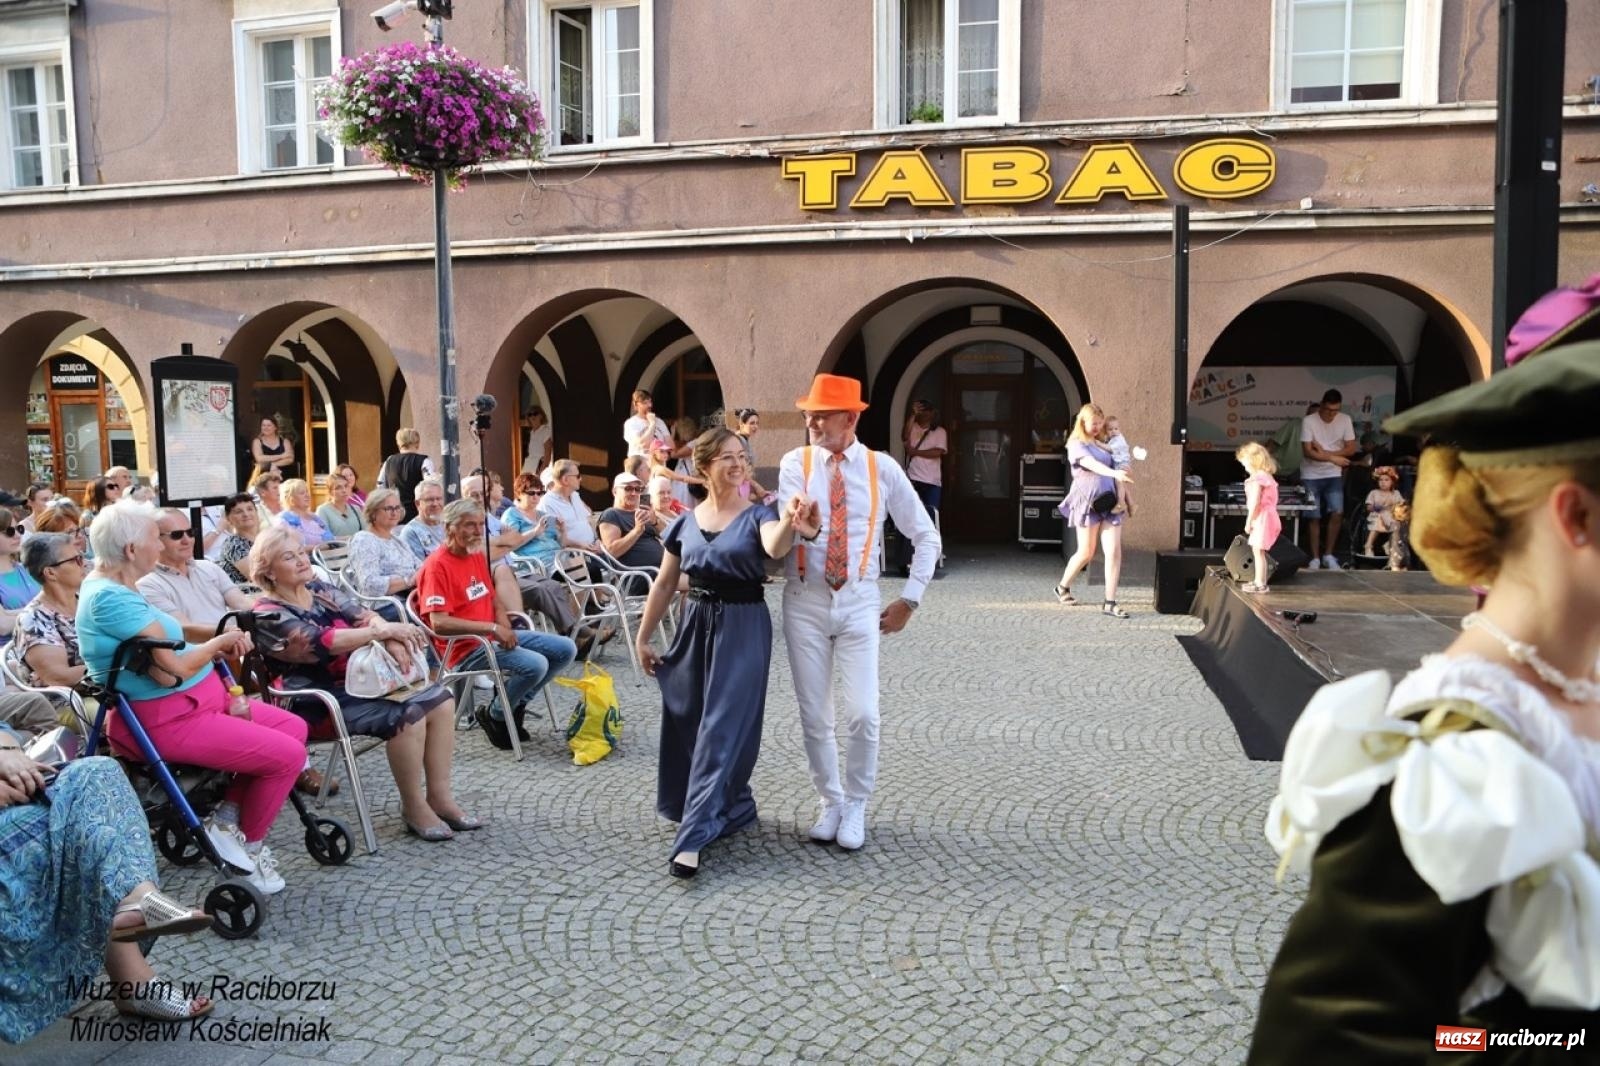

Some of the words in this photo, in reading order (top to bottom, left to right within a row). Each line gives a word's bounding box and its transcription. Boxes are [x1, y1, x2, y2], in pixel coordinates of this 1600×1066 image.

[782, 138, 1276, 210] TABAC
[59, 363, 88, 374] ZDJĘCIA
[52, 375, 97, 384] DOKUMENTY
